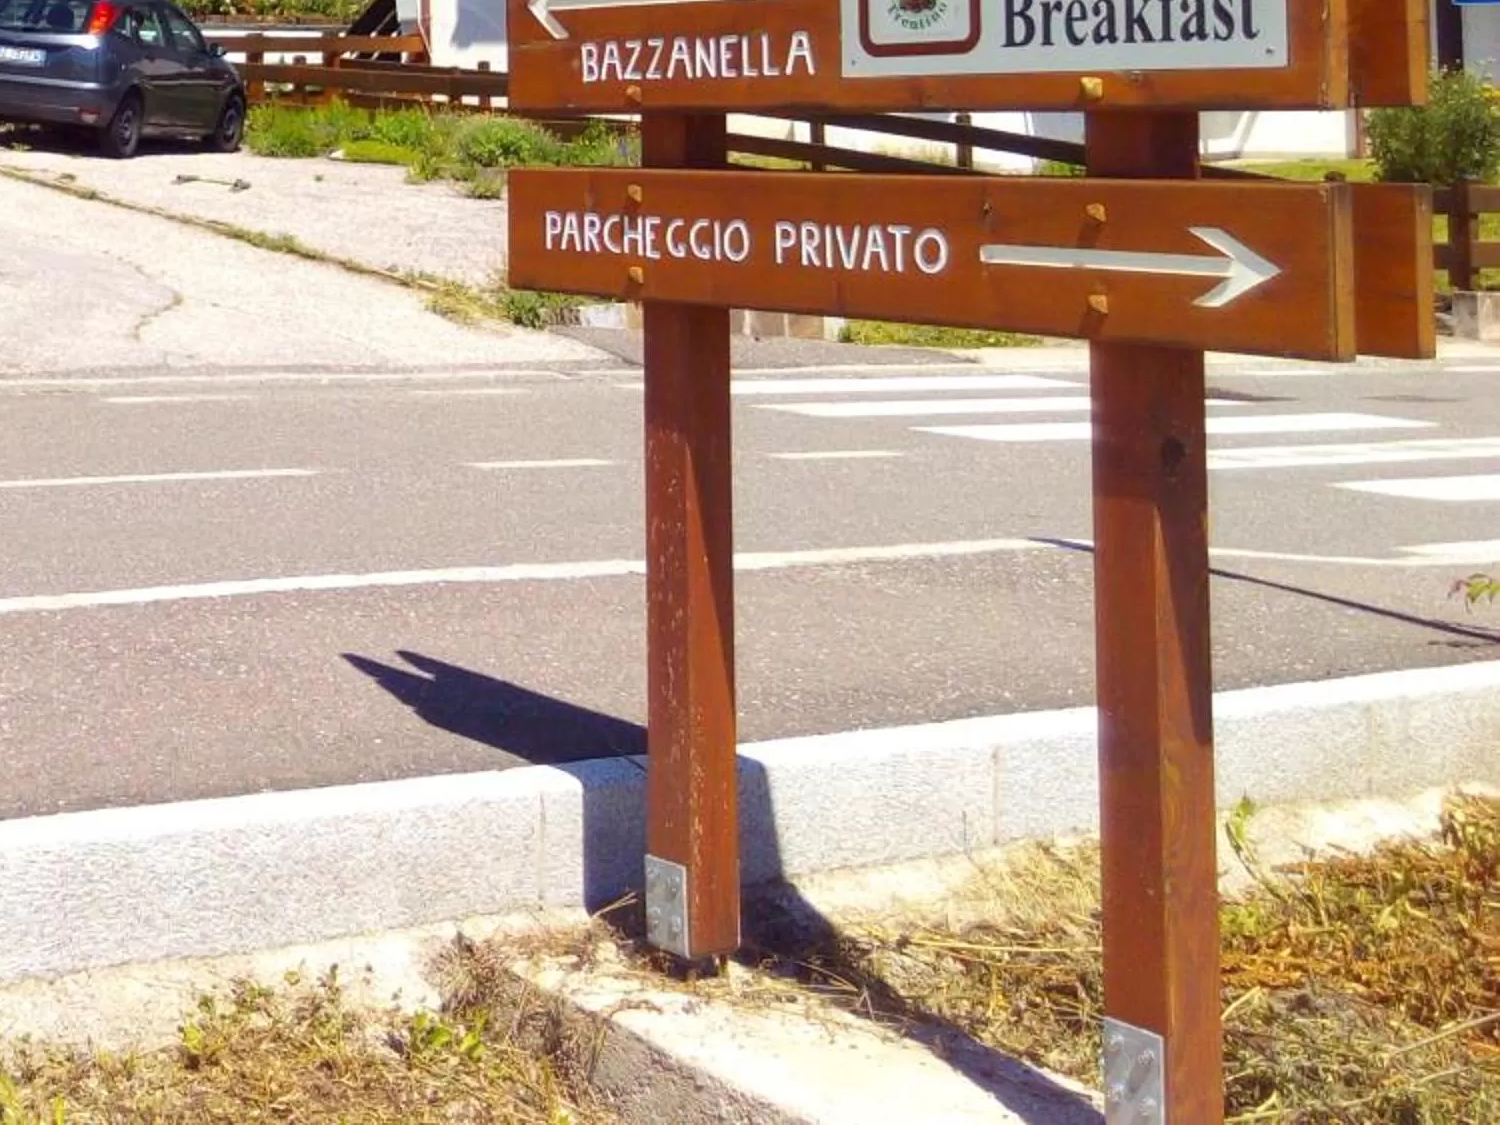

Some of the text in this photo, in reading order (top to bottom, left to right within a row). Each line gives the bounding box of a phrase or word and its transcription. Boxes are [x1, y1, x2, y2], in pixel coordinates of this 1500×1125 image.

[581, 30, 816, 84] BAZZANELLA
[545, 210, 950, 275] PARCHEGGIO PRIVATO
